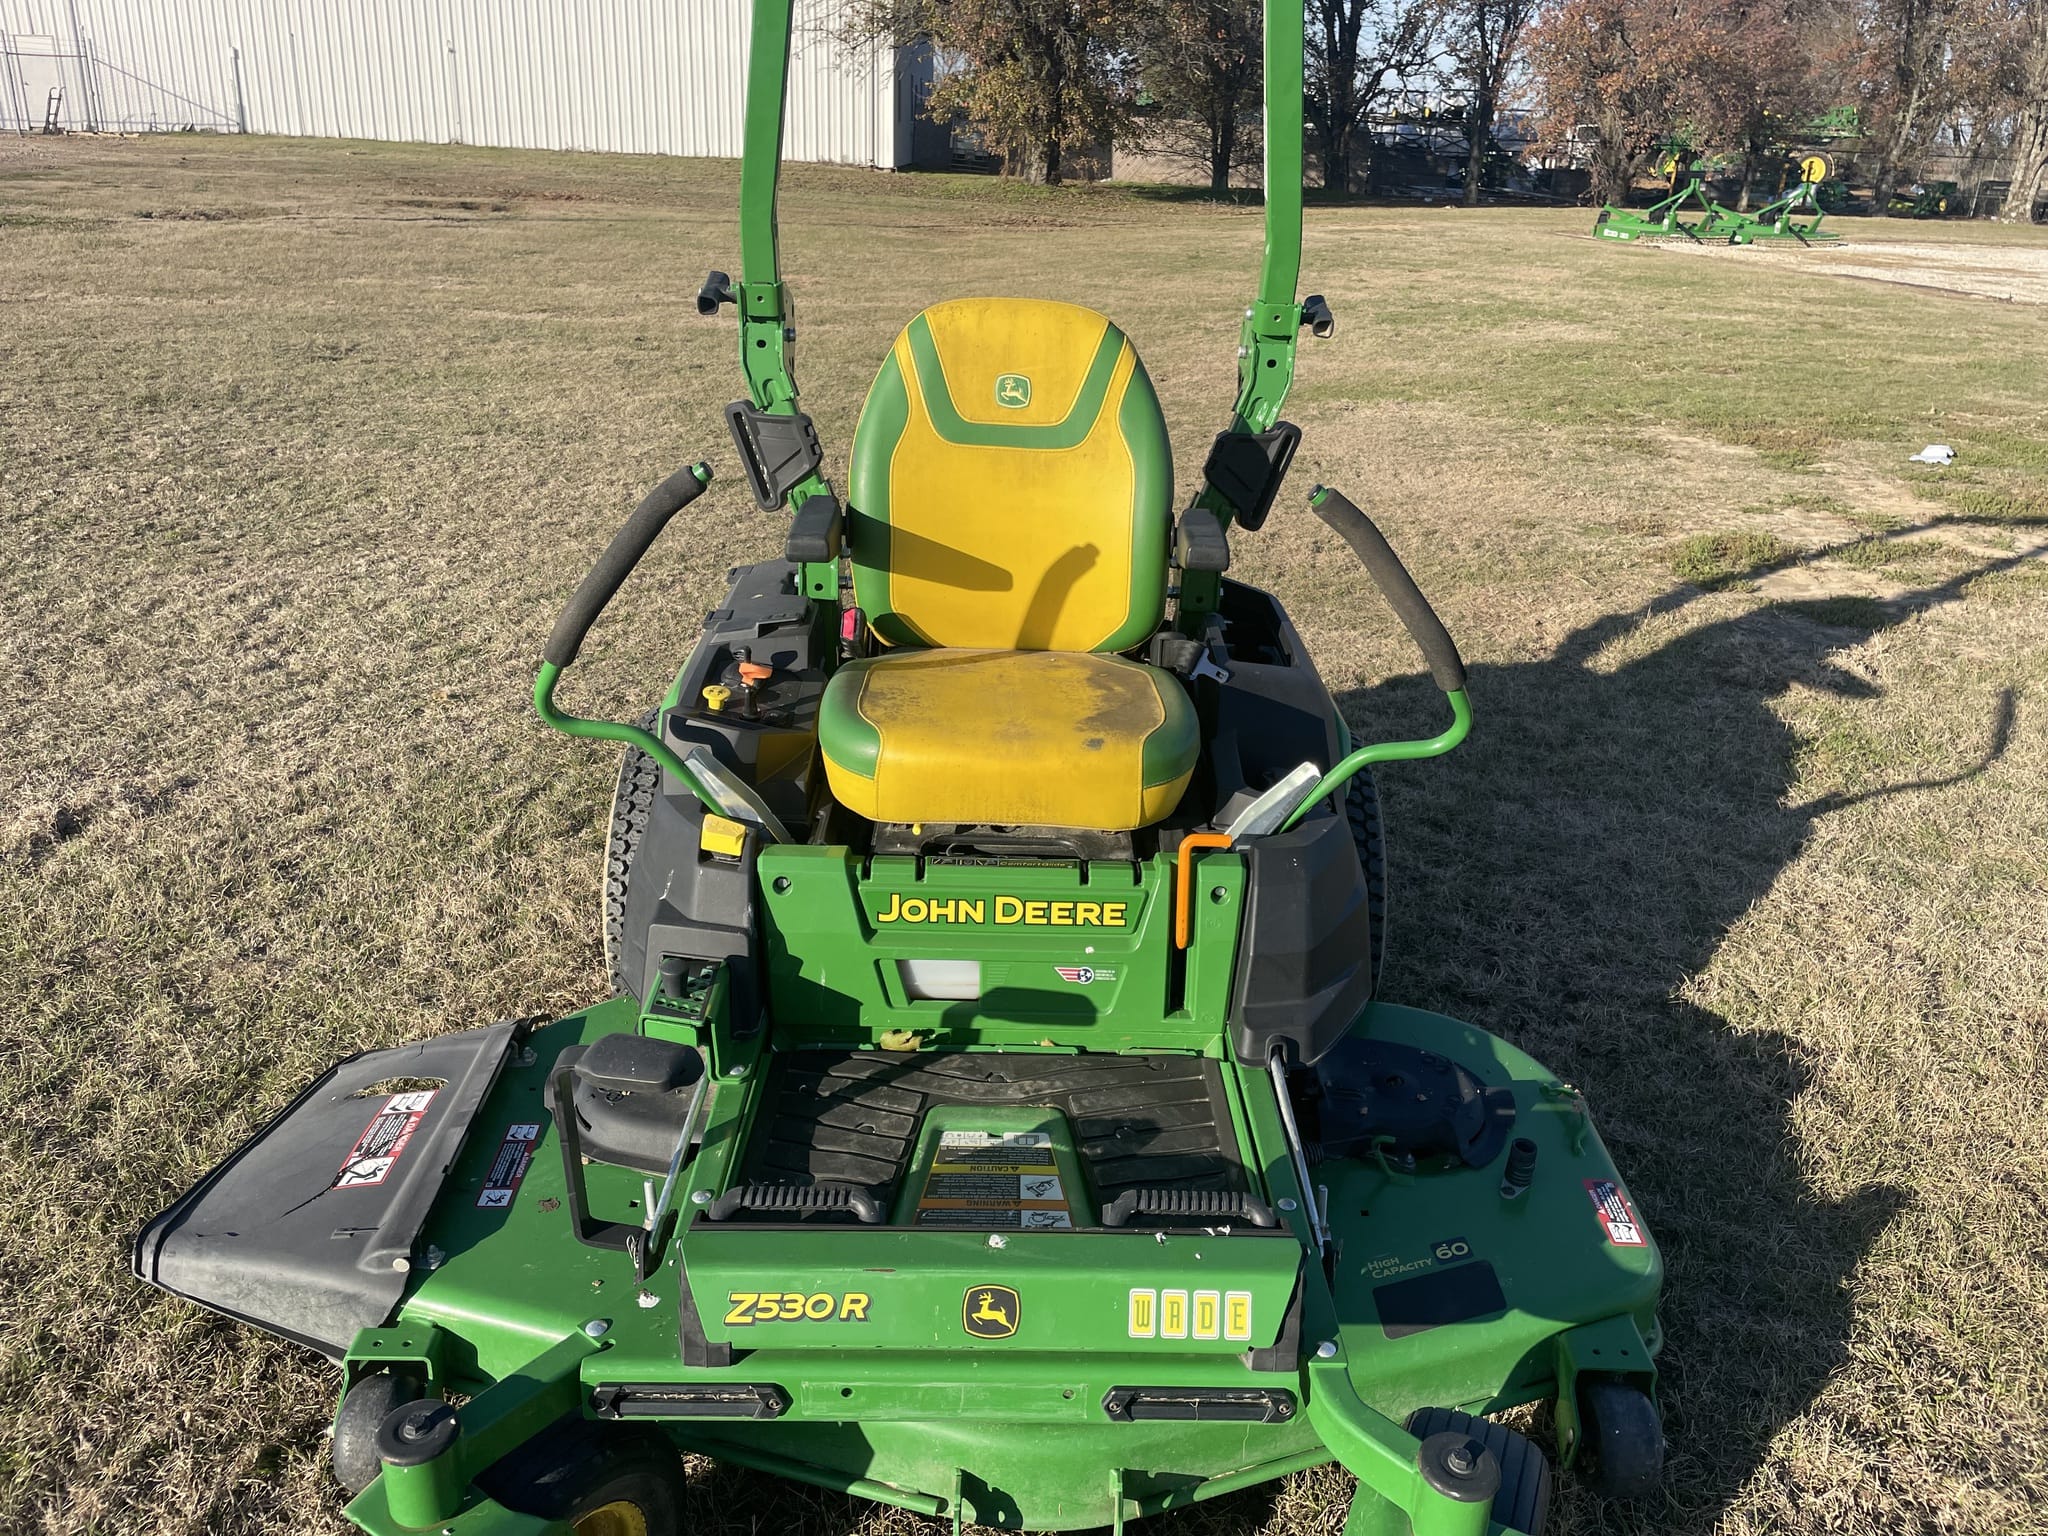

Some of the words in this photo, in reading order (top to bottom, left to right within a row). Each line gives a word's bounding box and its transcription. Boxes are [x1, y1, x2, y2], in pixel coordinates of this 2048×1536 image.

[877, 893, 985, 924] JOHN
[994, 895, 1127, 926] DEERE
[1435, 1242, 1469, 1260] 60
[1367, 1257, 1400, 1271] HIGH
[1371, 1258, 1433, 1279] CAPACITY
[1133, 1297, 1247, 1333] WADE
